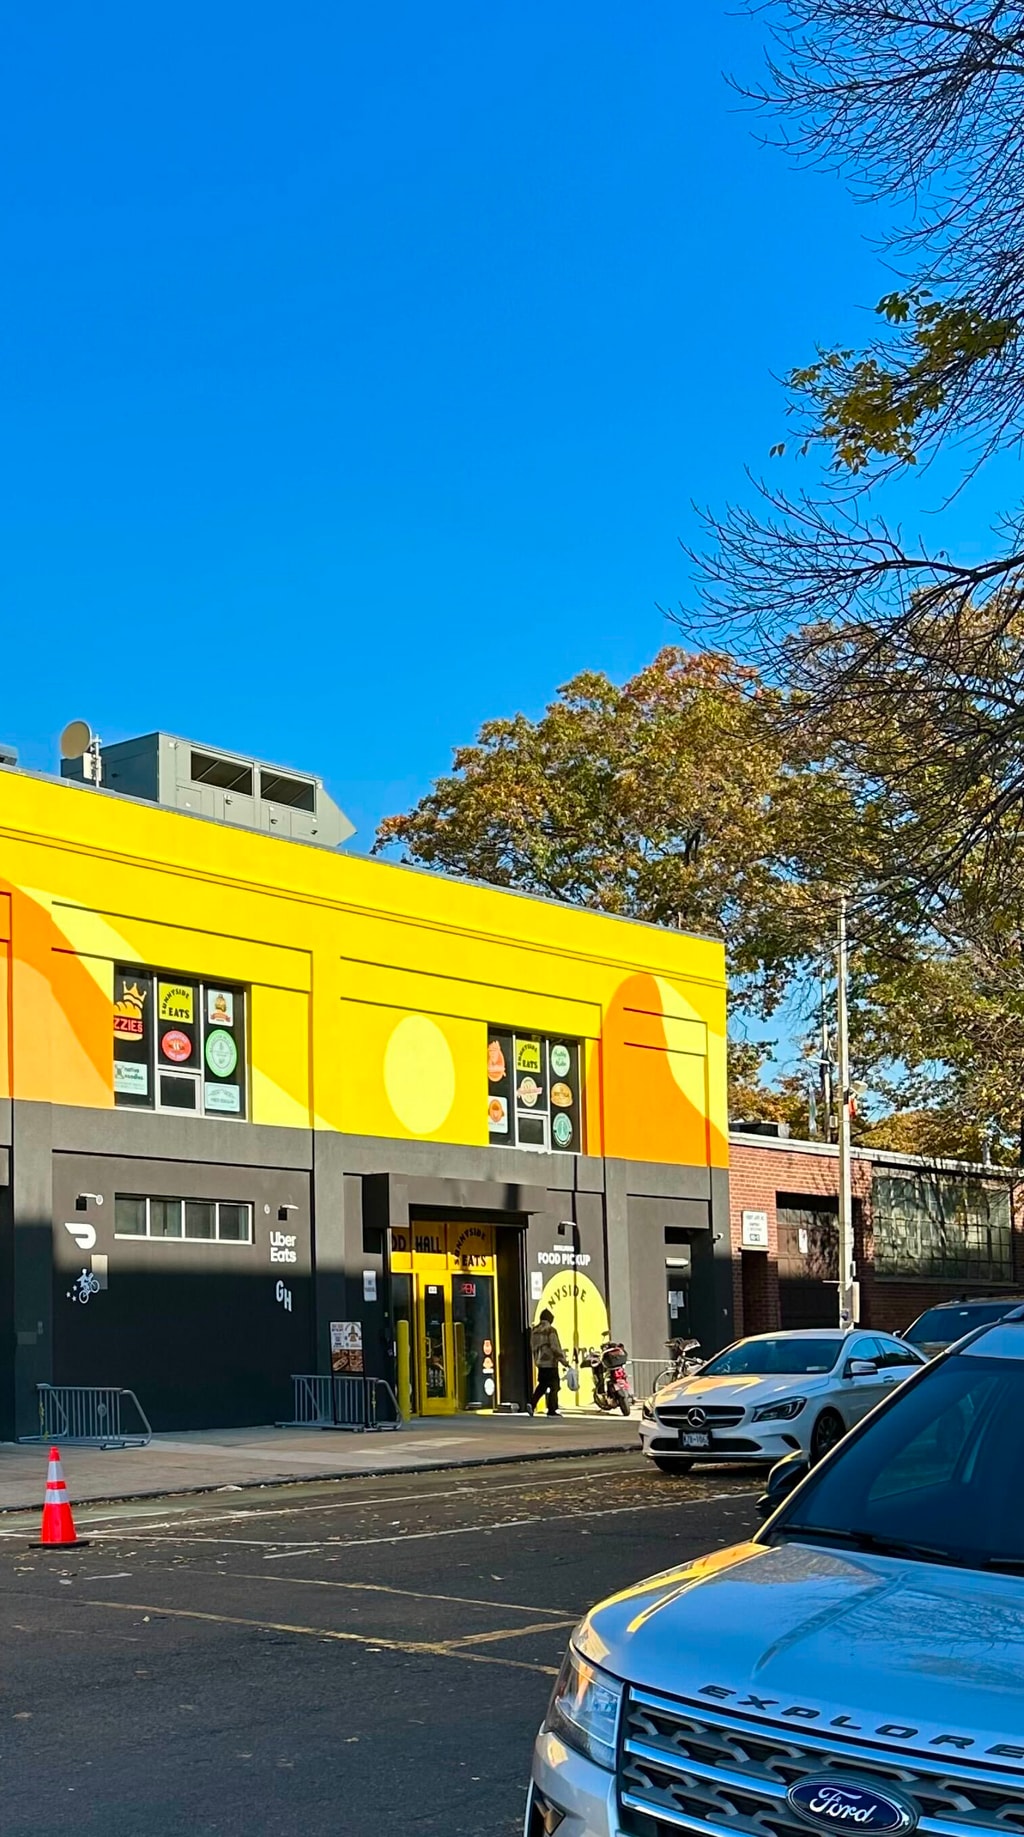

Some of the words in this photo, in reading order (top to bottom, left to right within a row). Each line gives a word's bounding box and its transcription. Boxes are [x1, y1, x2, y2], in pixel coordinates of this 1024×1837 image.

[161, 988, 190, 1015] SUNNYSIDE
[168, 1008, 190, 1019] EATS
[522, 1060, 538, 1069] EATS
[270, 1231, 296, 1247] Uber
[416, 1236, 442, 1253] HALL
[270, 1248, 297, 1263] Eats
[462, 1255, 486, 1267] EATS
[537, 1252, 561, 1265] FOOD
[276, 1280, 292, 1312] GH
[548, 1284, 587, 1309] NYSIDE
[809, 1786, 876, 1825] Ford
